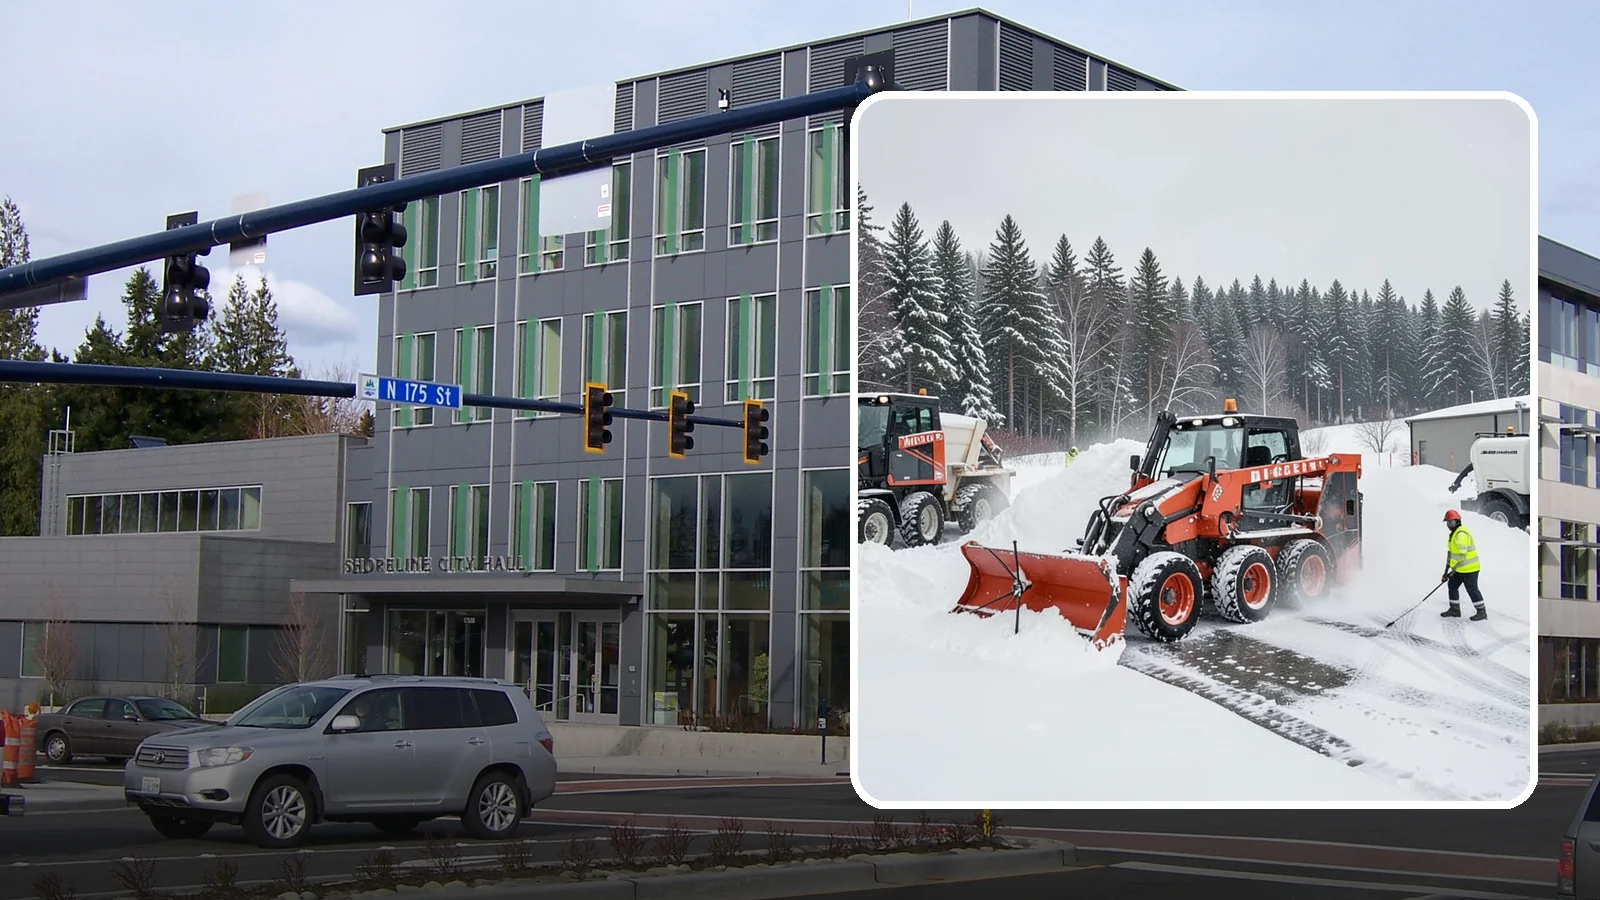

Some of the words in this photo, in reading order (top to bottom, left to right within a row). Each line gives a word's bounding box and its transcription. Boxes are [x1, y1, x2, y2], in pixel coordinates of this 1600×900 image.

[387, 381, 396, 400] N
[405, 383, 428, 403] 175
[436, 387, 451, 406] St
[344, 557, 432, 574] SHORELINE
[438, 556, 475, 572] CITY
[484, 555, 526, 571] HALL
